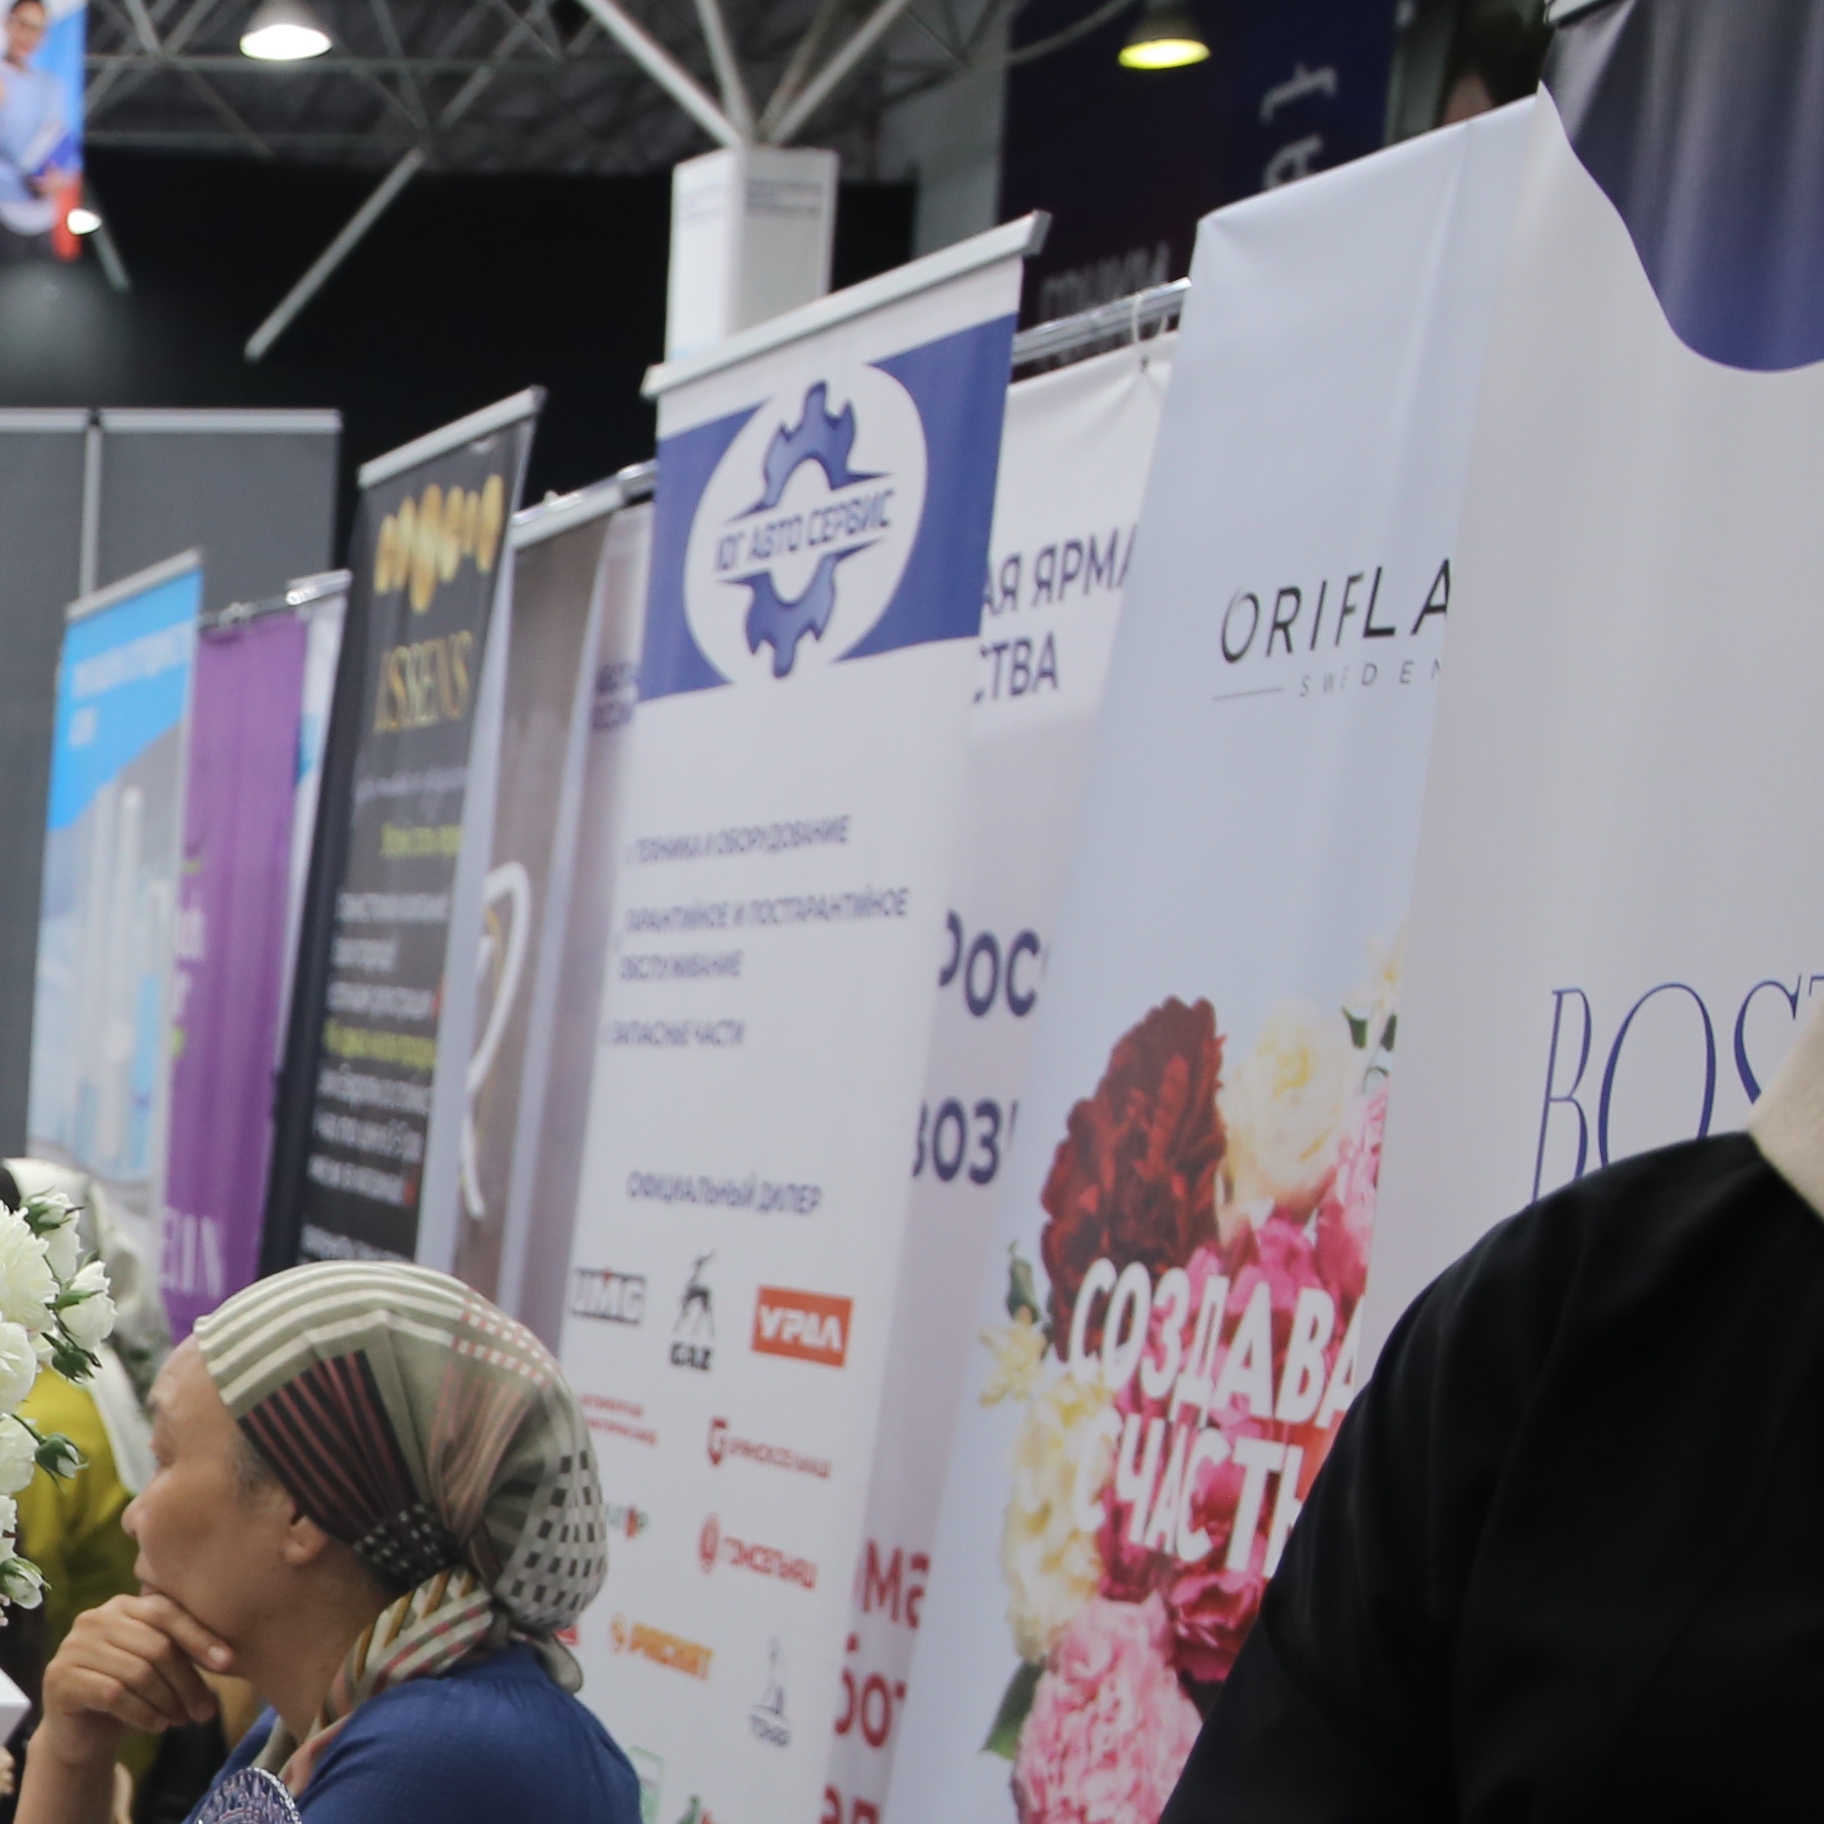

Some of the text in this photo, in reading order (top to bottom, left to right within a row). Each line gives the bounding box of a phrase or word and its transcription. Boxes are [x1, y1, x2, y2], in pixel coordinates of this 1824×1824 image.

[749, 515, 803, 560] АВТО
[808, 488, 896, 548] СЕРВИС
[973, 630, 1059, 703] ТВА
